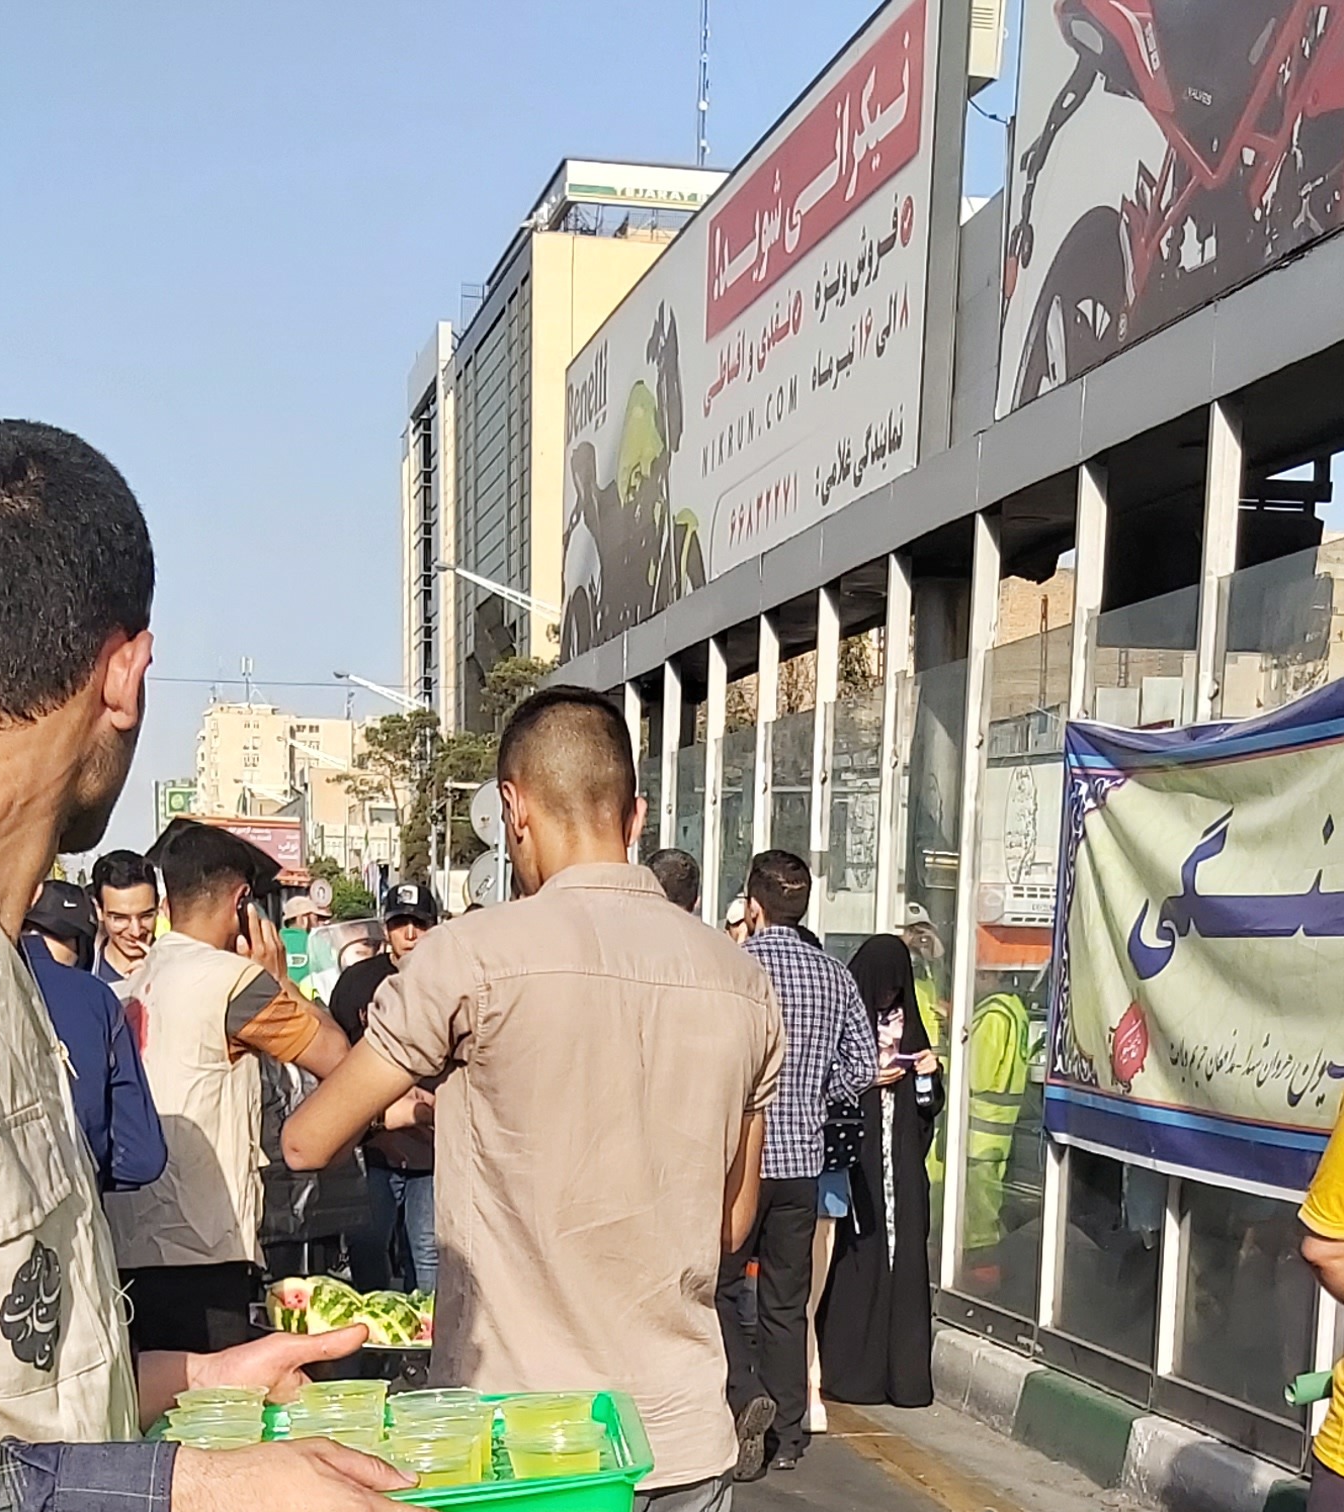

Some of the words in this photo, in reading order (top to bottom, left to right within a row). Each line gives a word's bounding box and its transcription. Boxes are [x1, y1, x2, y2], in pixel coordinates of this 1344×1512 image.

[851, 192, 898, 297] فروش
[757, 289, 792, 373] نقدی
[814, 260, 847, 322] ویژه
[876, 289, 898, 358] الی
[566, 338, 608, 443] Benelli
[703, 329, 746, 418] اقساطی
[701, 374, 798, 478] NIKRUN.COM
[854, 403, 905, 488] نمایندگی
